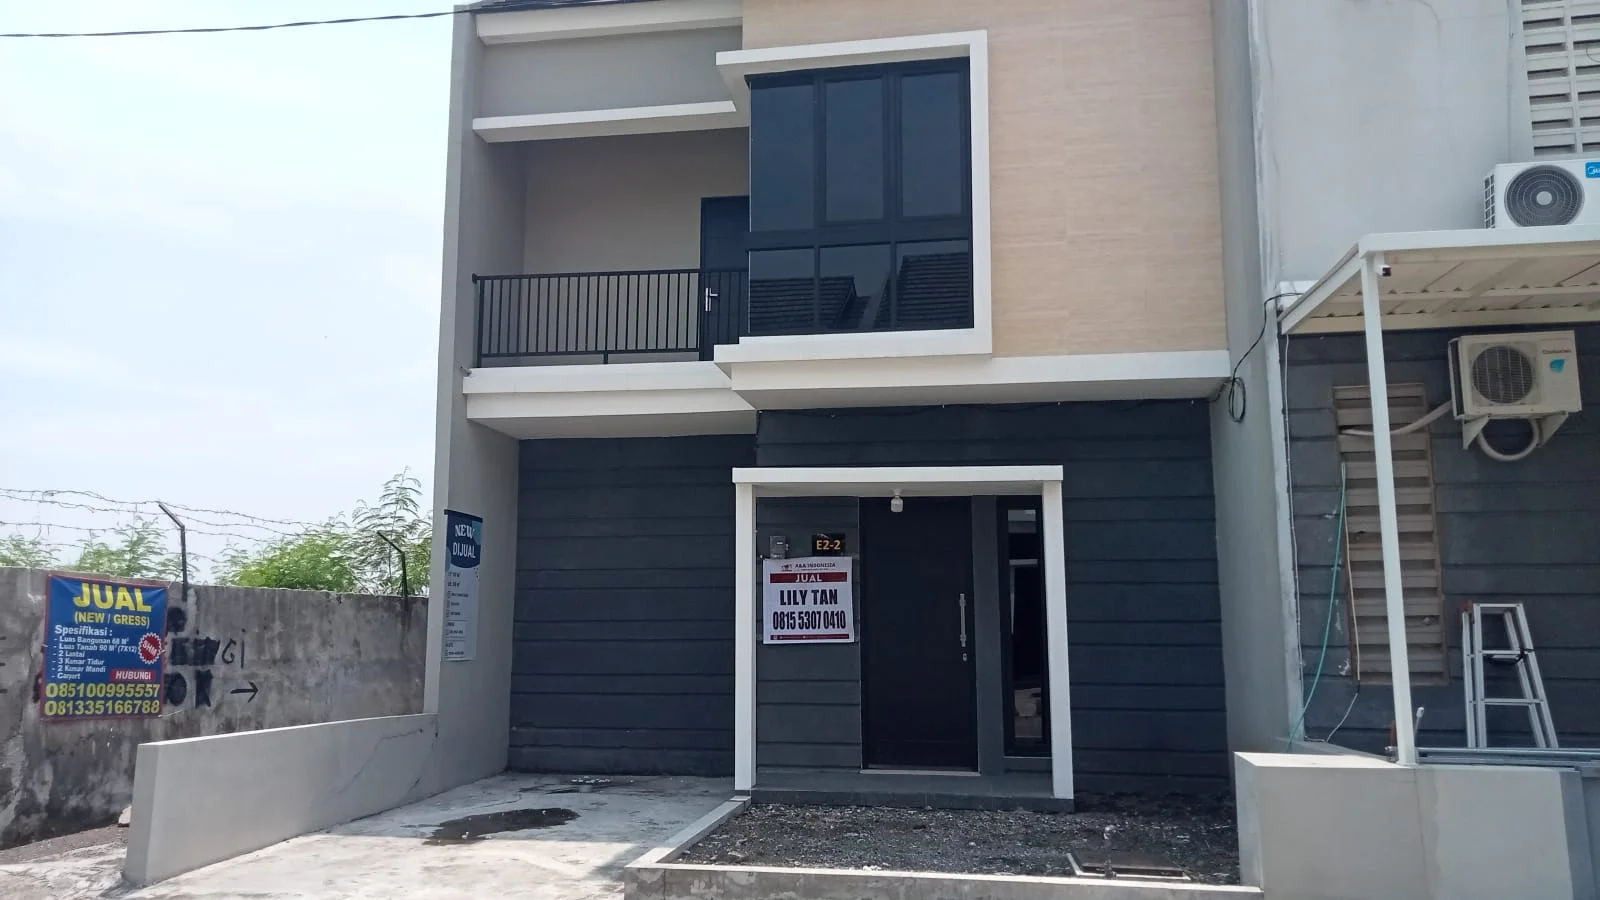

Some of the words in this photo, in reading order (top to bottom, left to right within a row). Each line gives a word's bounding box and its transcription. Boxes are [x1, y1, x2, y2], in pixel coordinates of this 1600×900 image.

[455, 524, 475, 539] NEW
[452, 542, 476, 559] DIJUAL
[816, 540, 841, 551] E2-2
[795, 573, 823, 583] JUAL
[73, 583, 152, 612] JUAL
[780, 589, 808, 606] LILY
[811, 588, 838, 606] TAN
[74, 611, 105, 625] (NEW
[113, 614, 150, 630] GRESS)
[773, 611, 796, 630] 0815
[798, 611, 821, 630] 5307
[823, 610, 846, 629] 0410
[54, 624, 108, 637] Spesifikasi
[58, 643, 75, 651] Luas
[77, 643, 98, 652] Tanah
[59, 635, 76, 643] Luas
[77, 637, 110, 646] Bangunan
[58, 650, 64, 658] 2
[142, 640, 158, 657] SHM
[115, 670, 151, 680] HUBUNGI
[45, 683, 160, 697] 085100995557
[45, 700, 160, 715] 081335166788
